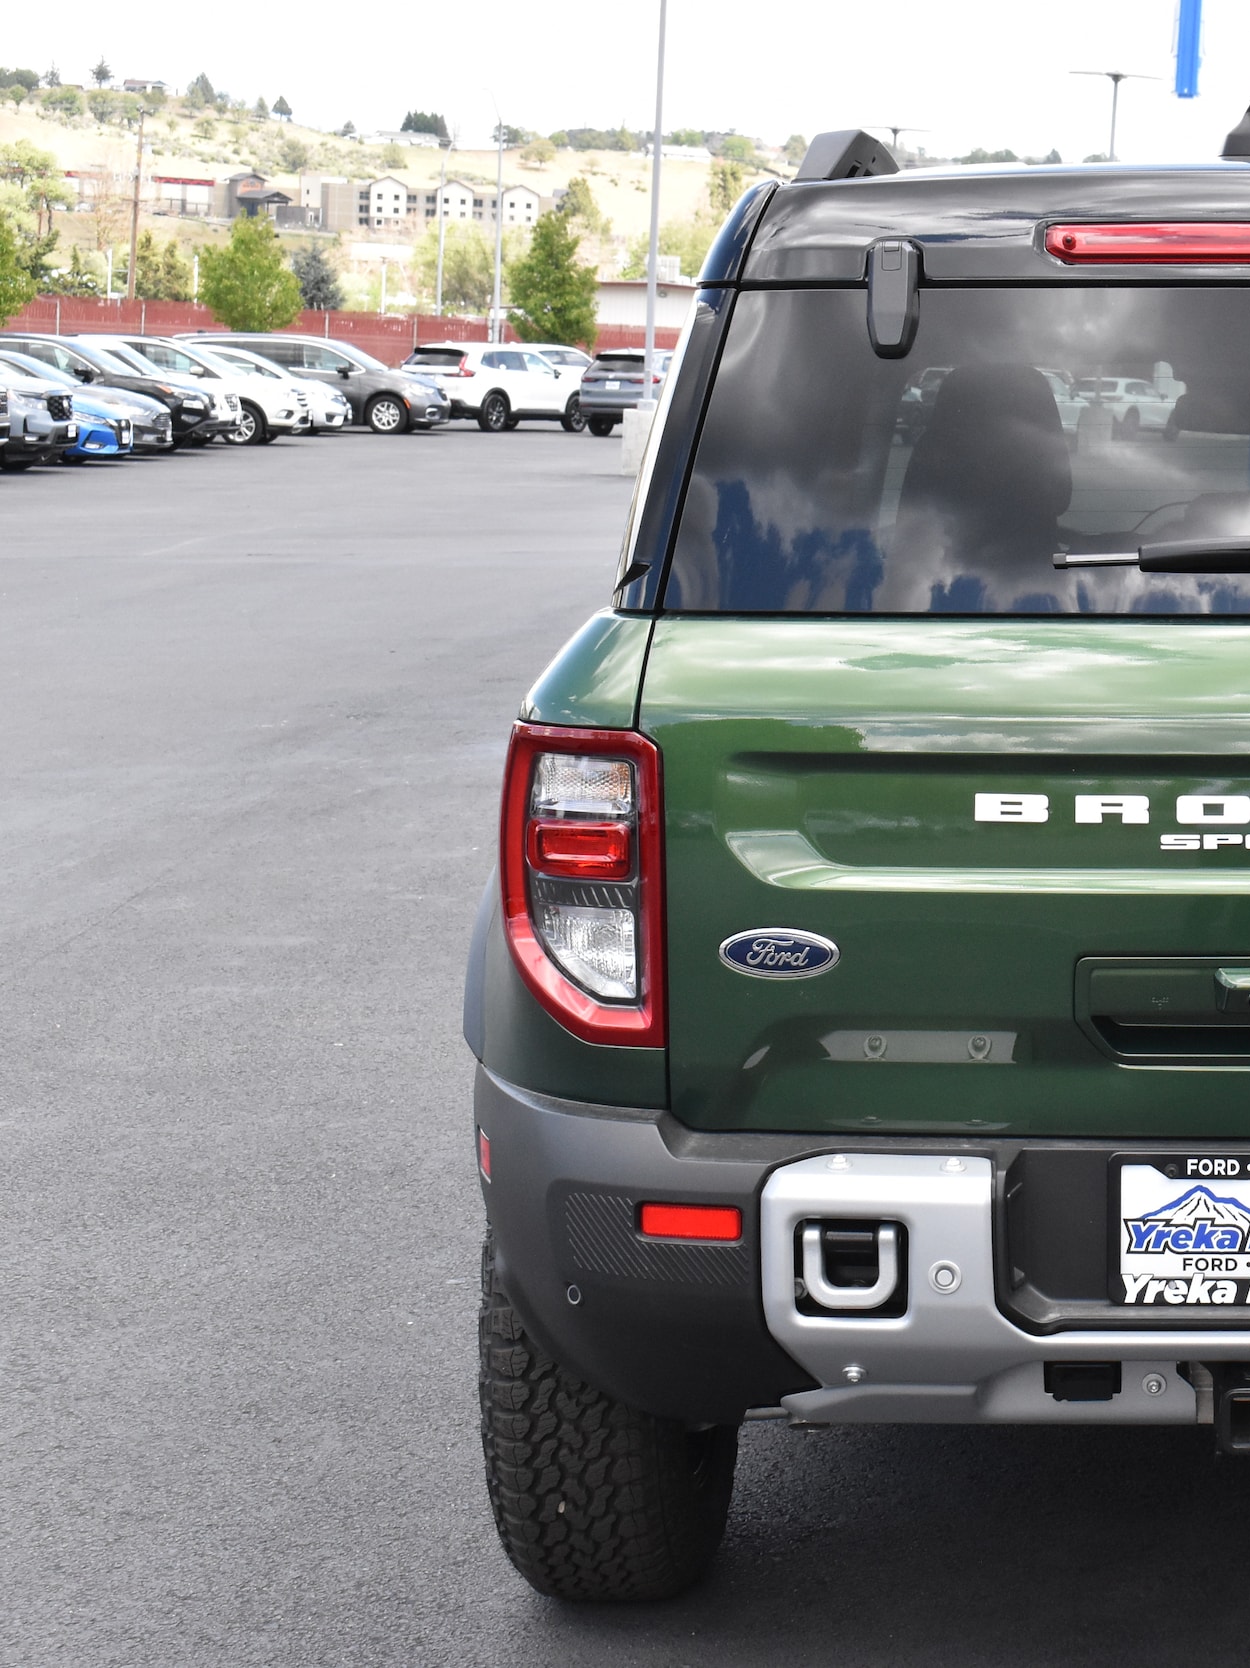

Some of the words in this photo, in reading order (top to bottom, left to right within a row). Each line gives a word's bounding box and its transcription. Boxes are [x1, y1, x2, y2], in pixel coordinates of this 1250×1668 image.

[746, 937, 809, 968] Ford
[1186, 1158, 1240, 1176] FORD
[1128, 1222, 1240, 1251] Yreka
[1182, 1257, 1238, 1272] FORD
[1121, 1273, 1238, 1305] Yreka
